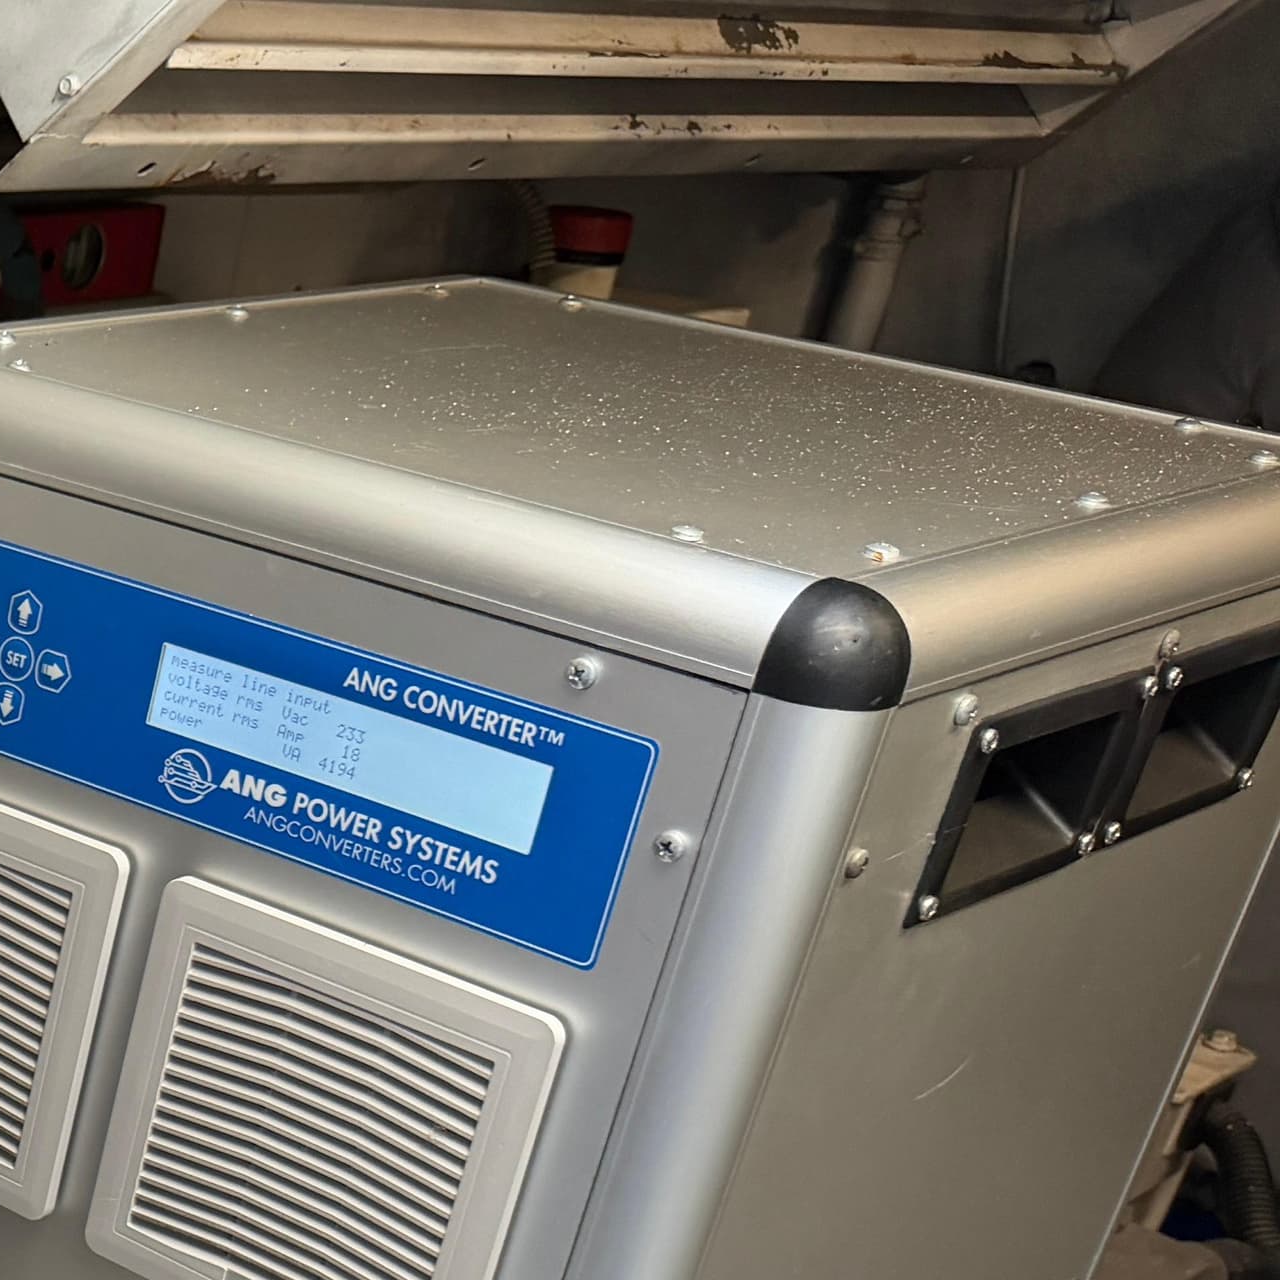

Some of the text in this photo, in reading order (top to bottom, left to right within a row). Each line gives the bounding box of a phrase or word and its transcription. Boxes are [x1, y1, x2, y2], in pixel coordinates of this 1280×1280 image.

[6, 651, 27, 669] SET
[171, 653, 332, 717] measure line input
[343, 667, 398, 703] ANG
[158, 706, 357, 780] power VA 4194
[163, 689, 361, 763] current rms Amp 18
[167, 671, 229, 702] voltage
[236, 693, 264, 713] rms
[336, 724, 368, 745] 233
[220, 769, 499, 886] ANG POWER SYSTEMS
[243, 805, 457, 896] ANGCONVERTERS.COM
